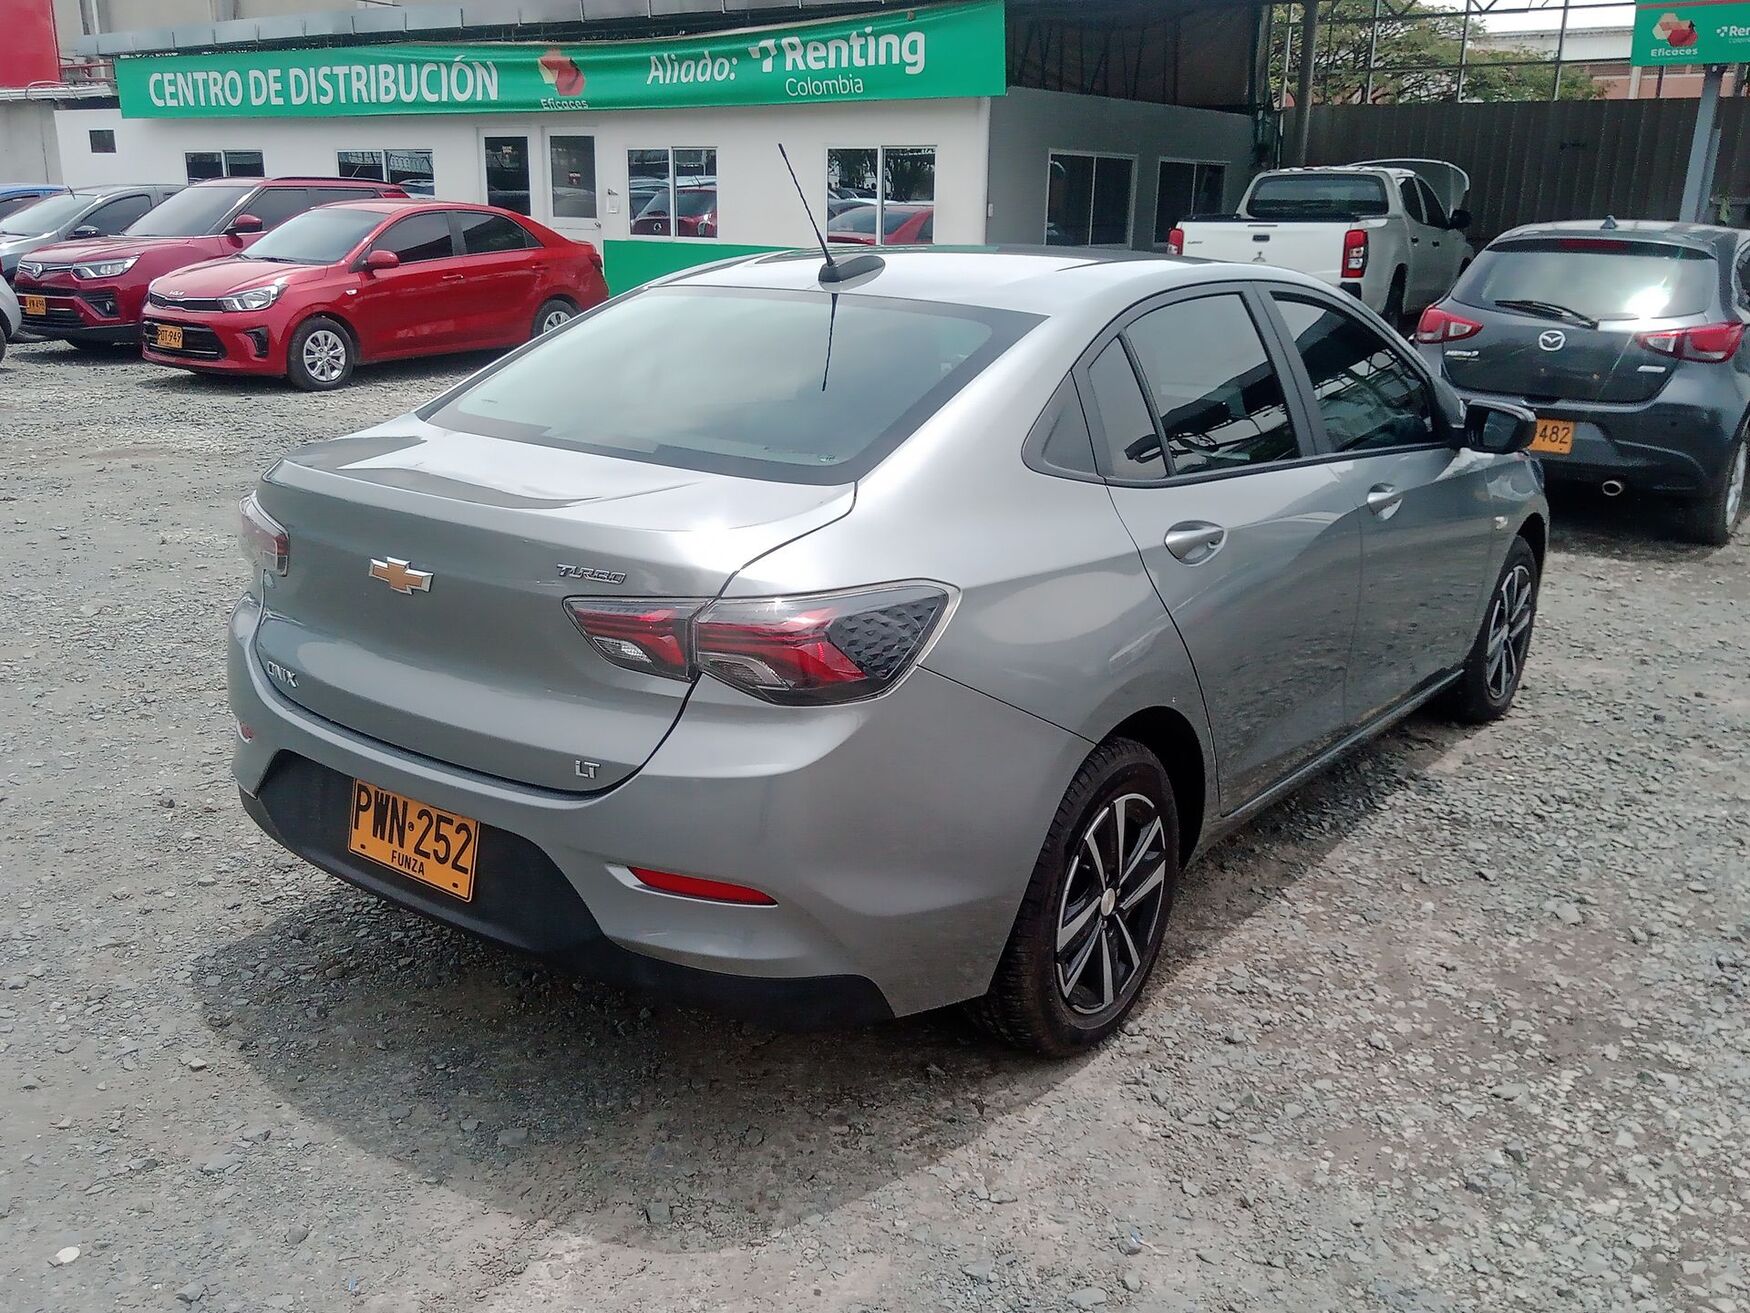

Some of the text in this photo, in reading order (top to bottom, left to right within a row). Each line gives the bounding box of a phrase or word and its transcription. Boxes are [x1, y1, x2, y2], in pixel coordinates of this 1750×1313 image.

[783, 26, 926, 74] Renting
[1650, 47, 1698, 57] Eficaces
[646, 51, 738, 84] Aliado:
[149, 54, 499, 107] CENTRO DE DISTRIBUCIÓN
[784, 76, 865, 98] Colombia
[540, 97, 589, 111] Eficaces
[1539, 424, 1570, 444] 482
[557, 563, 626, 584] TURBO
[575, 759, 600, 779] LT
[391, 850, 425, 876] FUNZA
